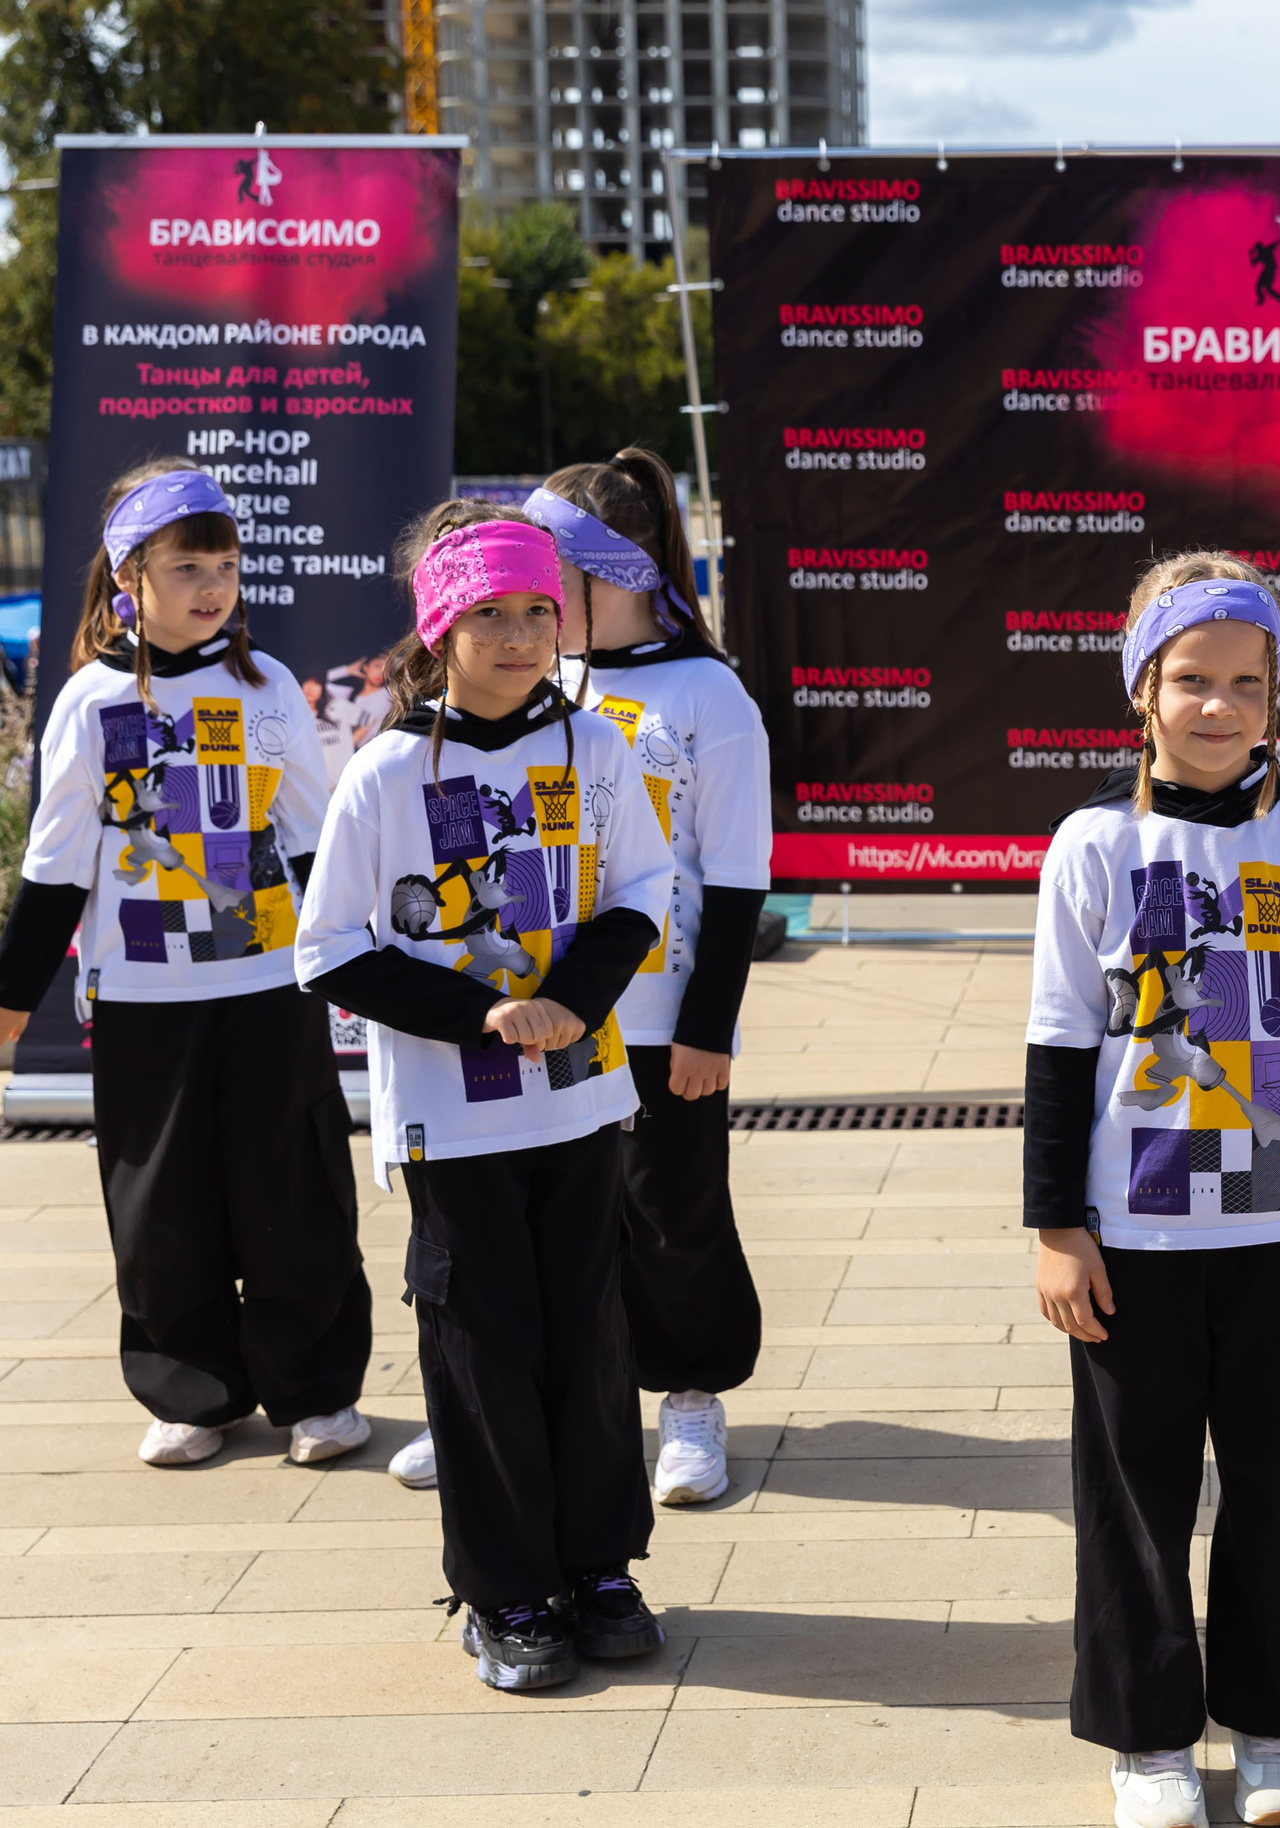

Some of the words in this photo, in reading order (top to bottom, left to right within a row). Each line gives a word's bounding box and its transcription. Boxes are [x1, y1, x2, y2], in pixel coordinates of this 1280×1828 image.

[775, 179, 921, 201] BRAVISSIMO
[776, 199, 846, 223] dance
[850, 199, 921, 223] studio
[149, 218, 382, 247] БРАВИССИМО
[153, 251, 300, 268] танцевальная
[305, 251, 376, 270] студия
[1000, 244, 1144, 266] BRAVISSIMO
[1001, 264, 1070, 288] dance
[1073, 264, 1144, 288] studio
[779, 304, 924, 326] BRAVISSIMO
[82, 324, 100, 346] В
[103, 324, 219, 349] КАЖДОМ
[224, 318, 323, 346] РАЙОНЕ
[327, 325, 427, 349] ГОРОДА
[781, 323, 849, 347] dance
[853, 324, 924, 348] studio
[137, 362, 221, 388] Танцы
[225, 366, 278, 388] для
[283, 362, 371, 390] детей,
[100, 397, 253, 419] подростков
[260, 399, 278, 414] и
[284, 398, 414, 419] взрослых
[1003, 388, 1070, 412] dance
[187, 429, 311, 456] HIP-HOP
[783, 427, 927, 449] BRAVISSIMO
[785, 446, 852, 470] dance
[856, 447, 926, 470] studio
[1003, 491, 1146, 512] BRAVISSIMO
[1005, 510, 1072, 533] dance
[1076, 511, 1145, 533] studio
[290, 554, 386, 579] танцы
[788, 549, 929, 569] BRAVISSIMO
[789, 566, 855, 590] dance
[860, 568, 928, 591] studio
[1005, 611, 1127, 631] BRAVISSIM
[1006, 630, 1072, 652] dance
[1077, 632, 1125, 653] stud
[791, 667, 931, 687] BRAVISSIMO
[793, 686, 859, 708] dance
[863, 687, 931, 709] studio
[197, 709, 240, 718] SLAM
[602, 706, 637, 721] SLAM
[102, 714, 146, 742] SPACE
[200, 744, 241, 752] DUNK
[1008, 747, 1074, 769] dance
[534, 780, 575, 790] SLAM
[796, 782, 935, 802] BRAVISSIMO
[427, 791, 480, 824] SPACE
[797, 801, 862, 823] dance
[866, 802, 934, 824] studio
[541, 821, 575, 831] DUNK
